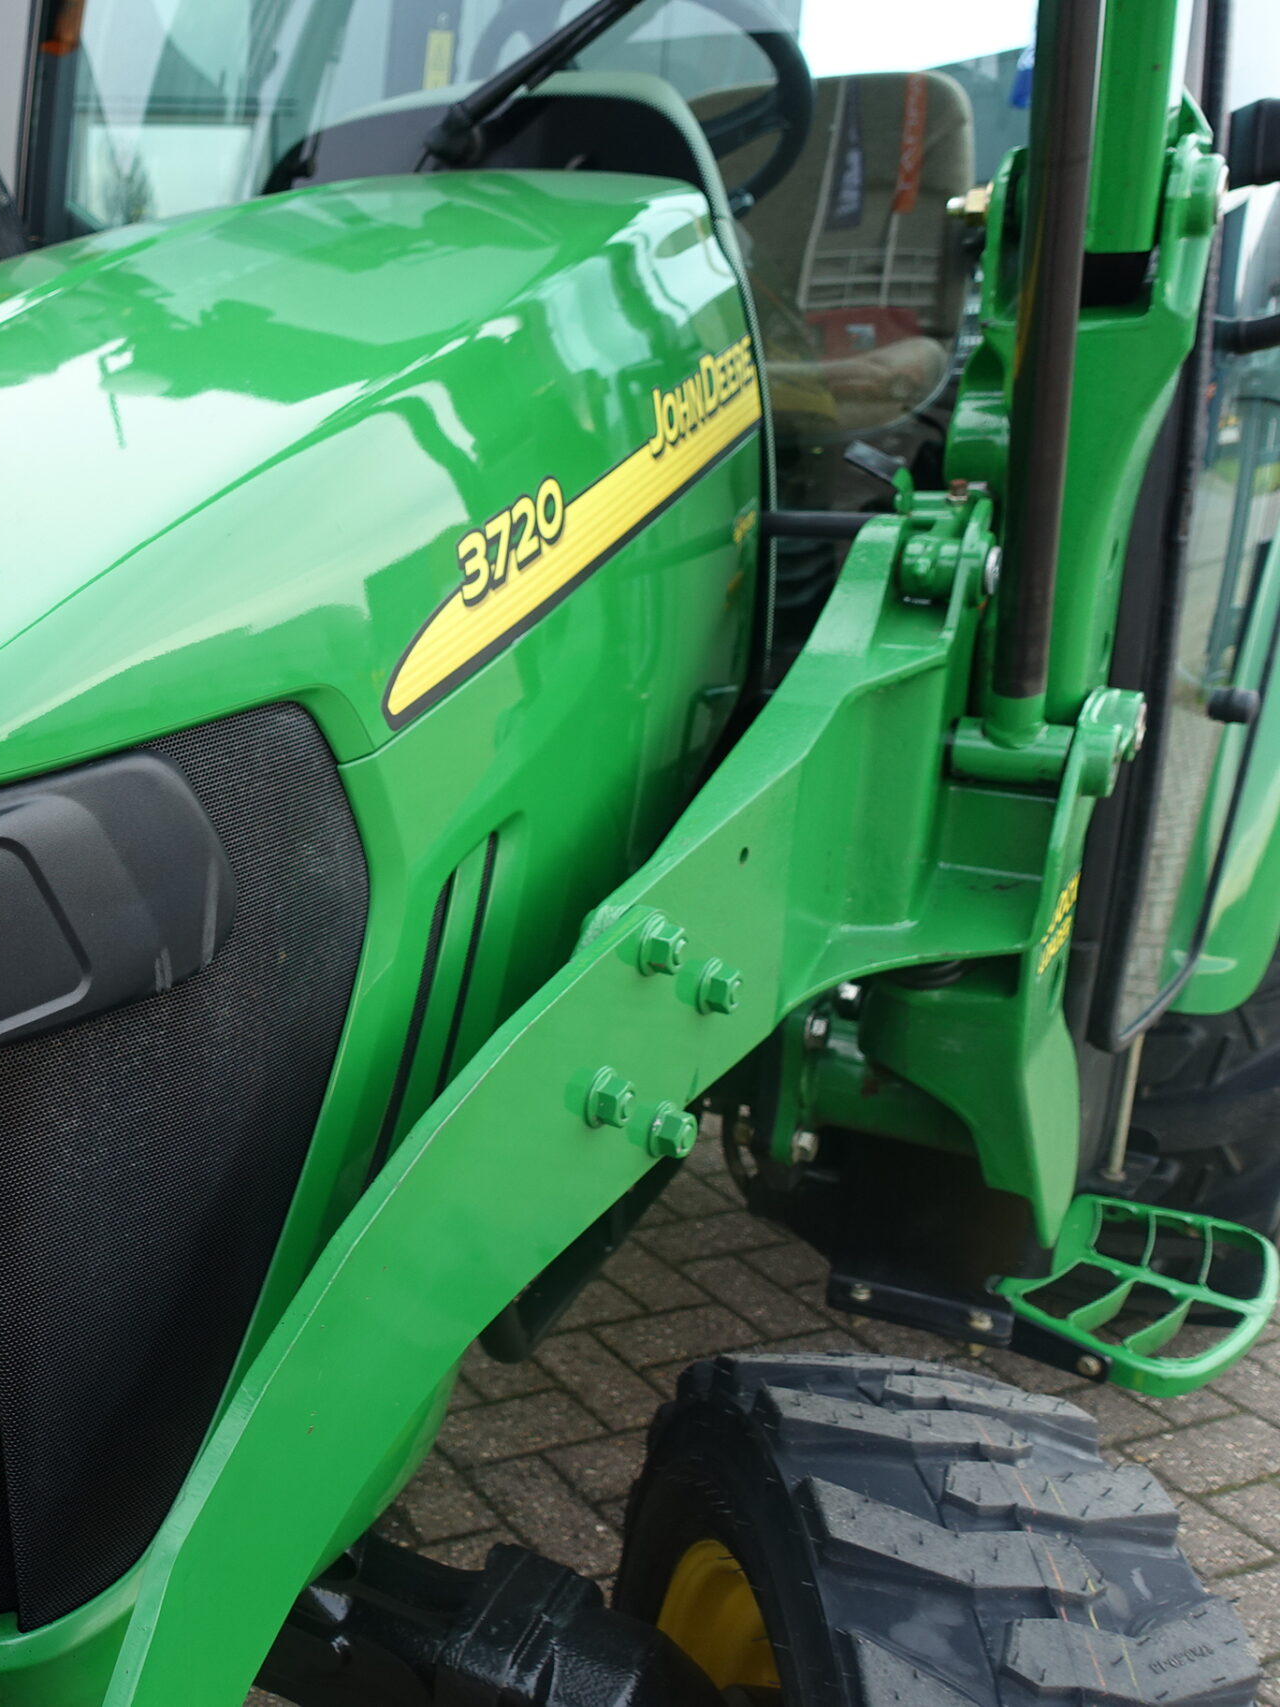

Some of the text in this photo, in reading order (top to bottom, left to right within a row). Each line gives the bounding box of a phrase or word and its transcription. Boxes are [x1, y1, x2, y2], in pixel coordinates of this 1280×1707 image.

[648, 333, 756, 456] JOHN DEERE
[456, 476, 564, 607] 3720
